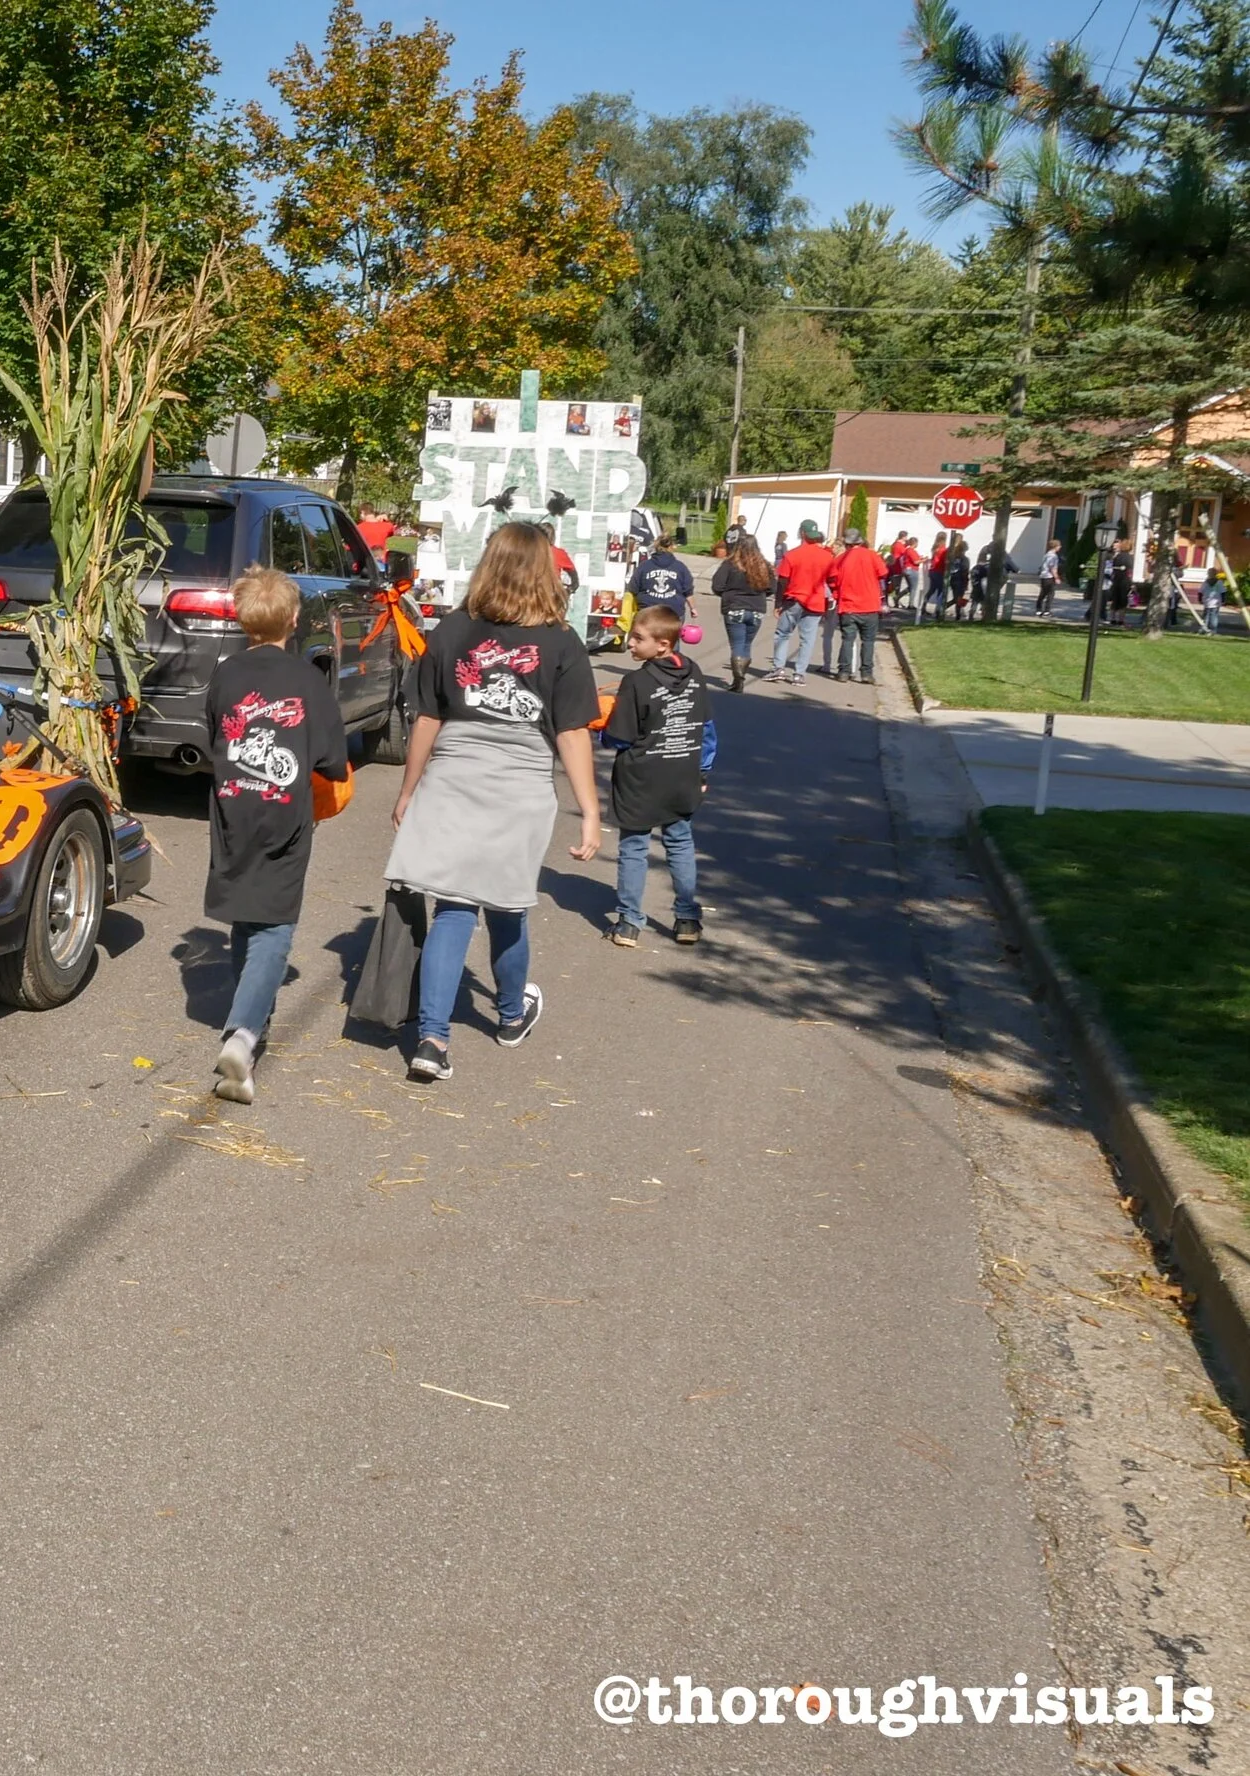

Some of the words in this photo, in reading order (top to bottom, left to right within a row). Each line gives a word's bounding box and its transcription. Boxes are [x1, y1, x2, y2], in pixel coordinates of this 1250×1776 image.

[412, 442, 647, 513] STAND
[935, 497, 980, 517] STOP
[442, 510, 608, 577] WH
